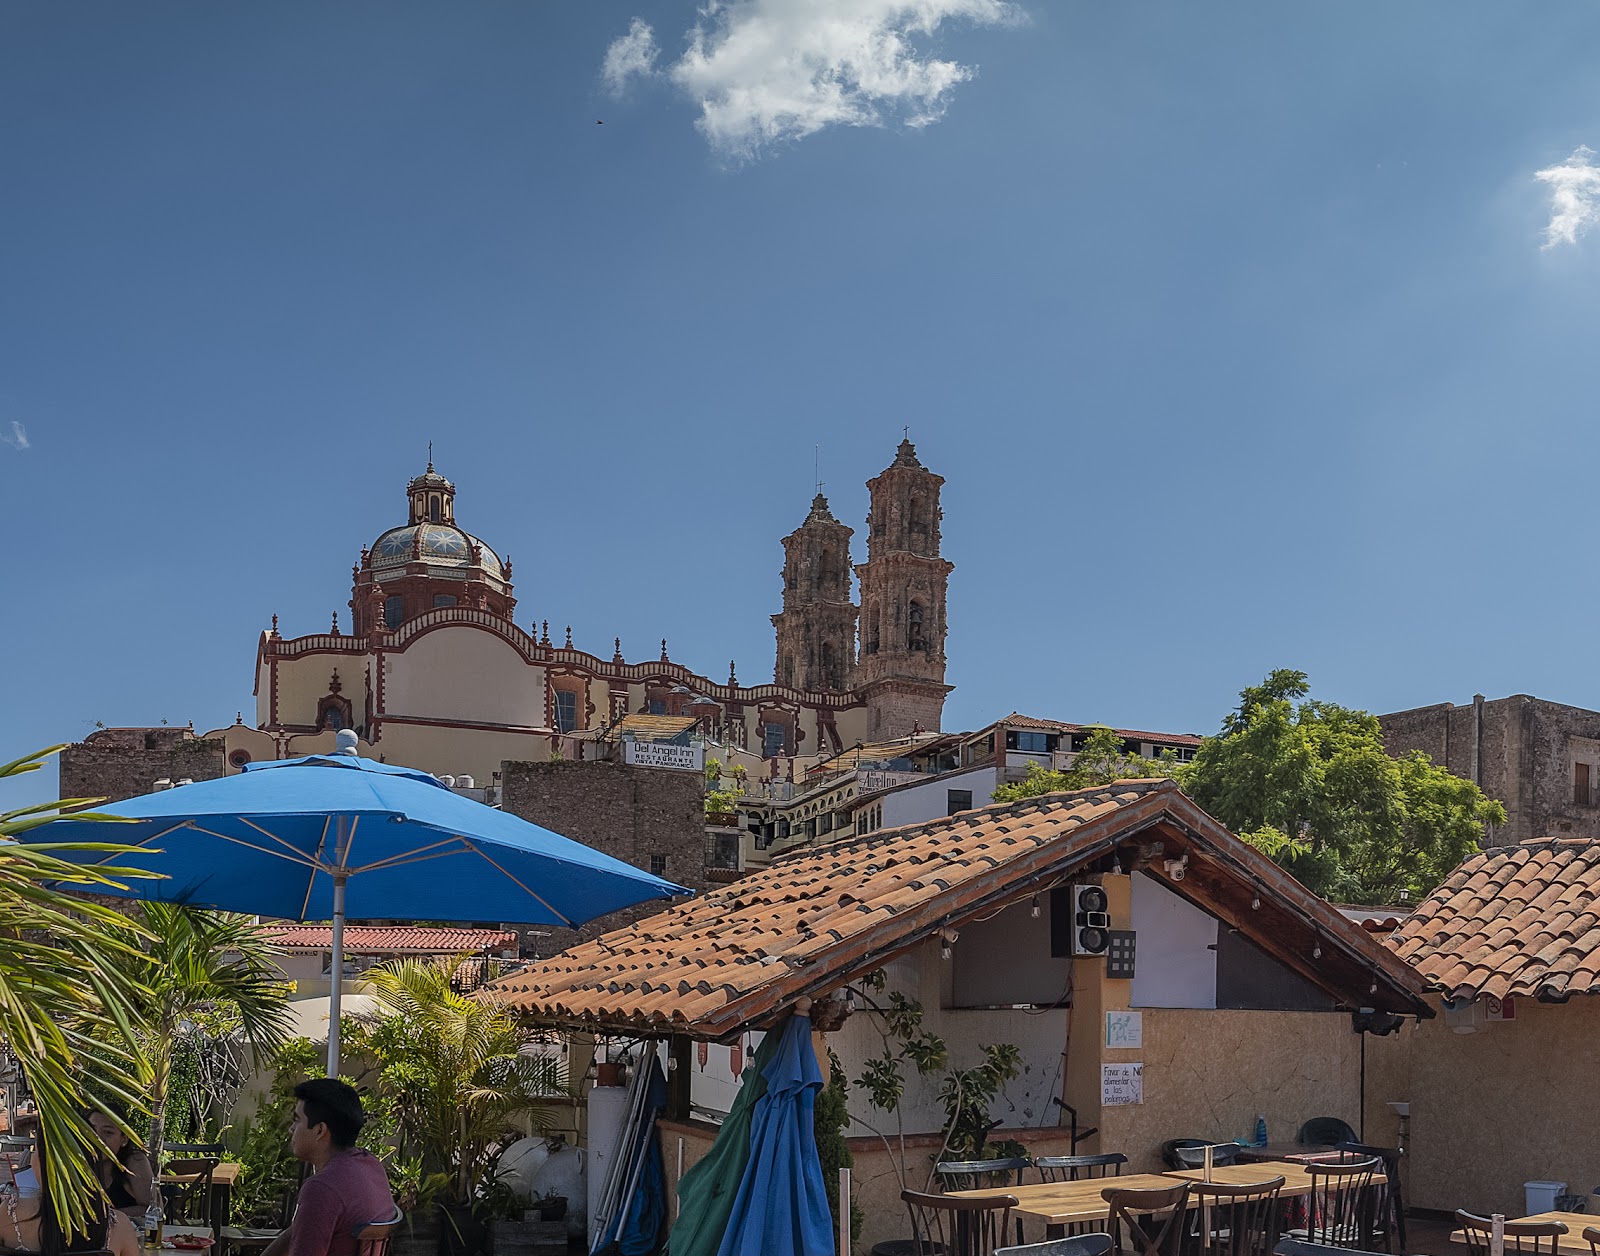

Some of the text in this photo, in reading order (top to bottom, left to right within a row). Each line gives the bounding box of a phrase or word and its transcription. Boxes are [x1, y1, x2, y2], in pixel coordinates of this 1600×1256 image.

[634, 743, 694, 757] Del Angel Inn
[635, 753, 694, 765] RESTAURANTE
[1104, 1066, 1120, 1076] Favor
